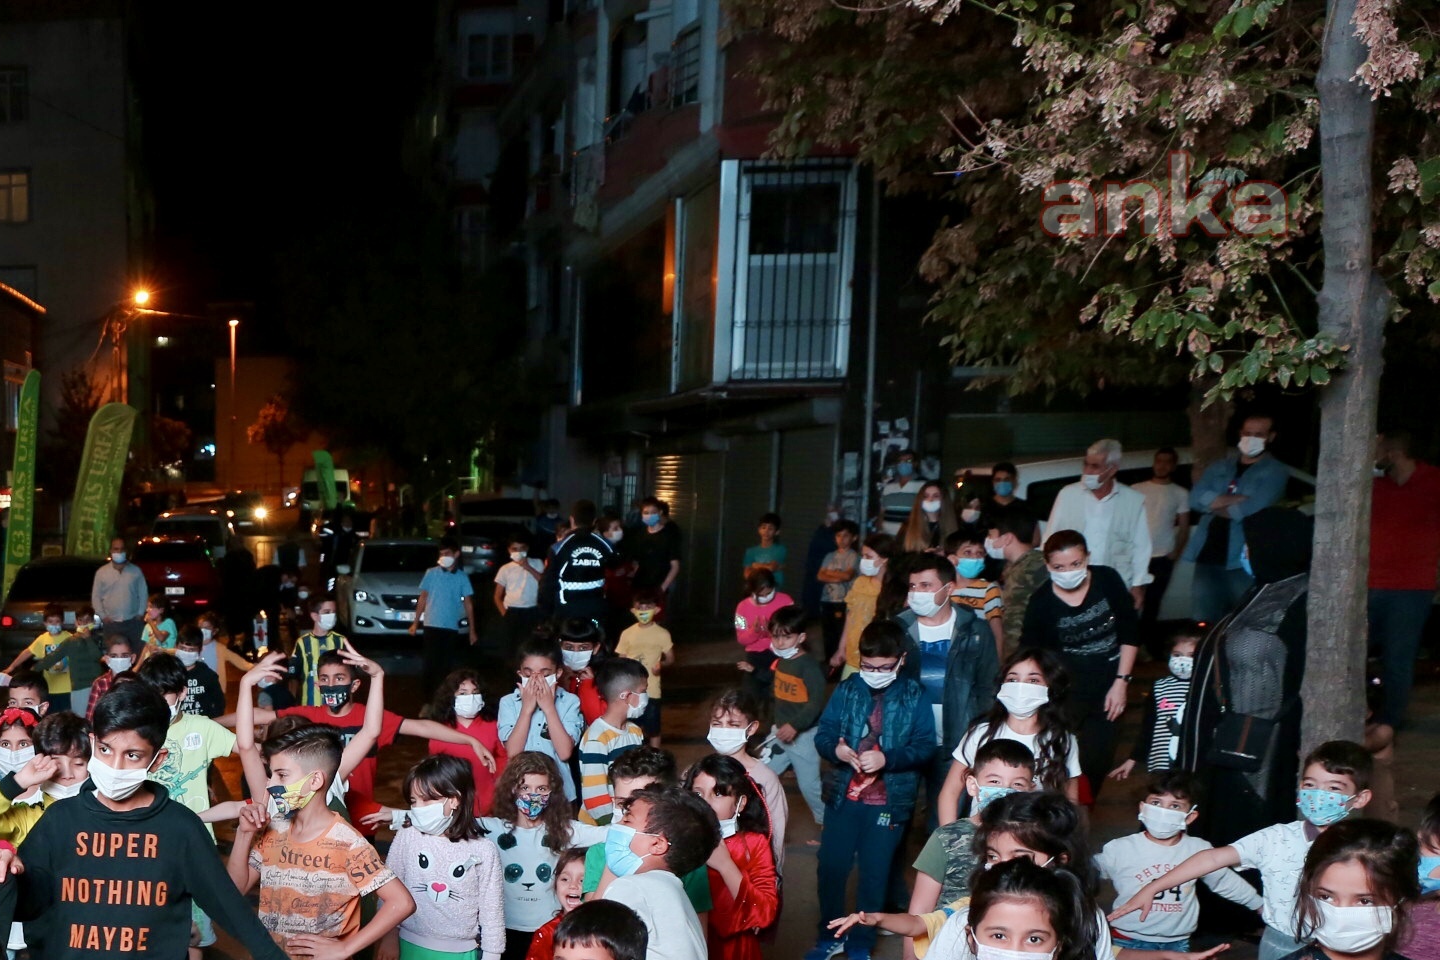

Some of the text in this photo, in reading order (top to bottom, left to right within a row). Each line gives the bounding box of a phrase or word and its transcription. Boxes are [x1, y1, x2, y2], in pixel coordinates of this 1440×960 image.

[572, 558, 601, 567] ZABITA
[76, 831, 158, 858] SUPER
[279, 846, 332, 869] Street
[61, 877, 168, 907] NOTHING
[69, 923, 150, 952] MAYBE
